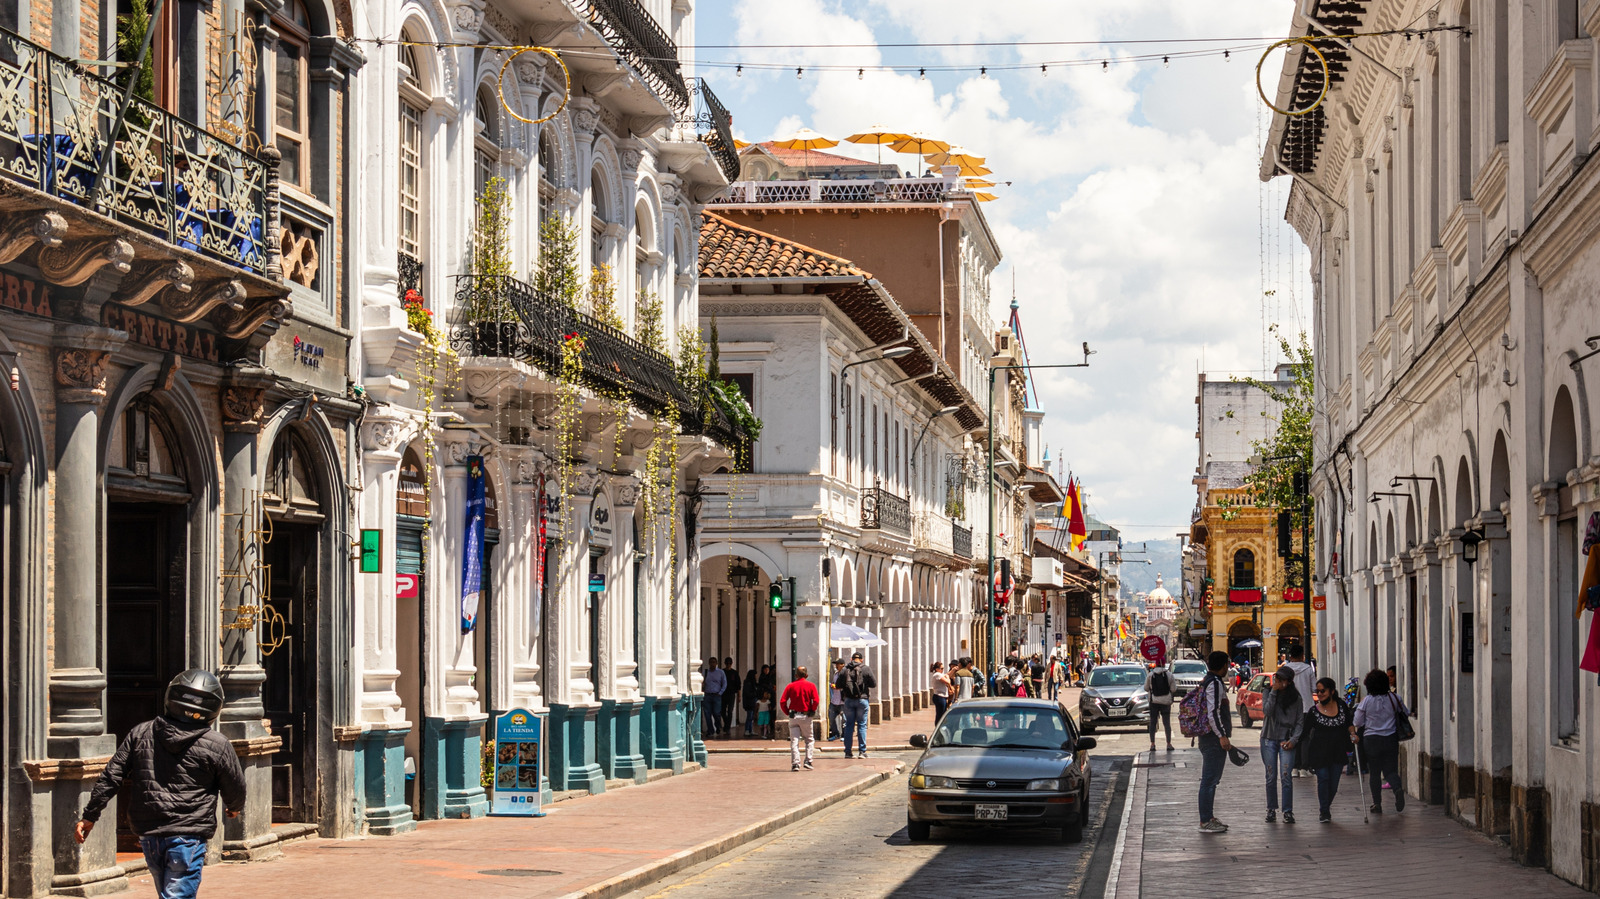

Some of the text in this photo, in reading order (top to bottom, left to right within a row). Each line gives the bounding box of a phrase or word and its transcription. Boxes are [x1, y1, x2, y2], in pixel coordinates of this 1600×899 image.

[0, 272, 53, 318] RIA
[103, 304, 219, 363] CENTRAL
[402, 480, 425, 496] TIENDA
[976, 809, 1007, 818] PRP-762
